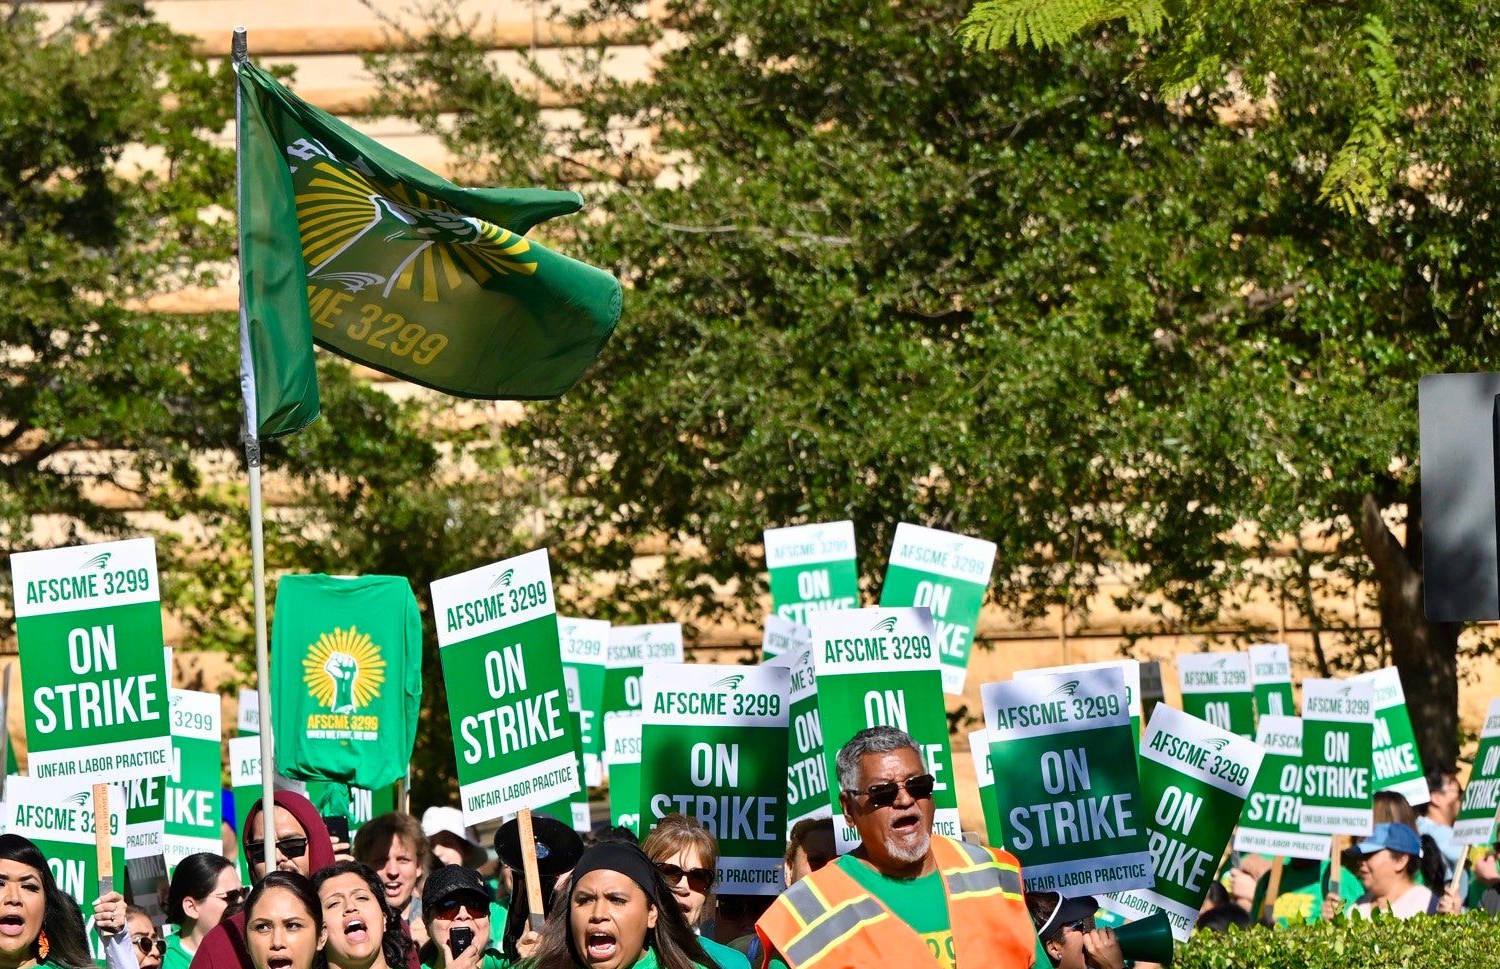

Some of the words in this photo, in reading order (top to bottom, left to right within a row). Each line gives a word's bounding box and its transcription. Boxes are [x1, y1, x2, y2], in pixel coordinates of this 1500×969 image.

[347, 304, 448, 365] 3299
[900, 544, 947, 566] AFSCME
[952, 556, 985, 575] 3299
[27, 574, 97, 604] AFSCME
[103, 568, 149, 595] 3299
[798, 570, 830, 600] ON
[447, 593, 506, 632] AFSCME
[509, 581, 547, 613] 3299
[68, 624, 117, 675] ON
[568, 639, 600, 655] 3299
[647, 640, 676, 657] 3299
[825, 637, 887, 663] AFSCME
[892, 635, 931, 660] 3299
[485, 644, 526, 699] ON
[1184, 672, 1218, 685] AFSCME
[1222, 671, 1246, 684] 3299
[33, 674, 160, 734] STRIKE
[654, 692, 727, 715] AFSCME
[733, 694, 780, 716] 3299
[997, 701, 1068, 730] AFSCME
[1072, 694, 1120, 720] 3299
[1308, 698, 1342, 713] AFSCME
[1345, 700, 1369, 715] 3299
[175, 711, 212, 731] 3299
[308, 714, 349, 729] AFSCME
[351, 715, 378, 730] 3299
[460, 690, 564, 764] STRIKE
[795, 708, 823, 754] ON
[1149, 730, 1209, 769] AFSCME
[1210, 756, 1250, 787] 3299
[1324, 731, 1349, 763] ON
[37, 761, 75, 778] UNFAIR
[79, 757, 114, 774] LABOR
[116, 750, 166, 770] PRACTICE
[690, 743, 739, 787] ON
[1040, 748, 1091, 795] ON
[468, 787, 500, 812] UNFAIR
[503, 779, 531, 801] LABOR
[533, 767, 572, 793] PRACTICE
[1304, 764, 1368, 799] STRIKE
[16, 804, 76, 832] AFSCME
[81, 811, 118, 835] 329
[1009, 793, 1137, 850] STRIKE
[1155, 786, 1203, 837] ON
[1303, 815, 1321, 824] UNFAIR
[1323, 816, 1340, 825] LABOR
[1342, 817, 1368, 827] PRACTICE
[127, 832, 158, 848] PRACTICE
[726, 869, 778, 884] PRACTICE
[1057, 869, 1092, 888] LABOR
[1095, 864, 1147, 884] PRACTICE
[1120, 894, 1149, 912] LABOR
